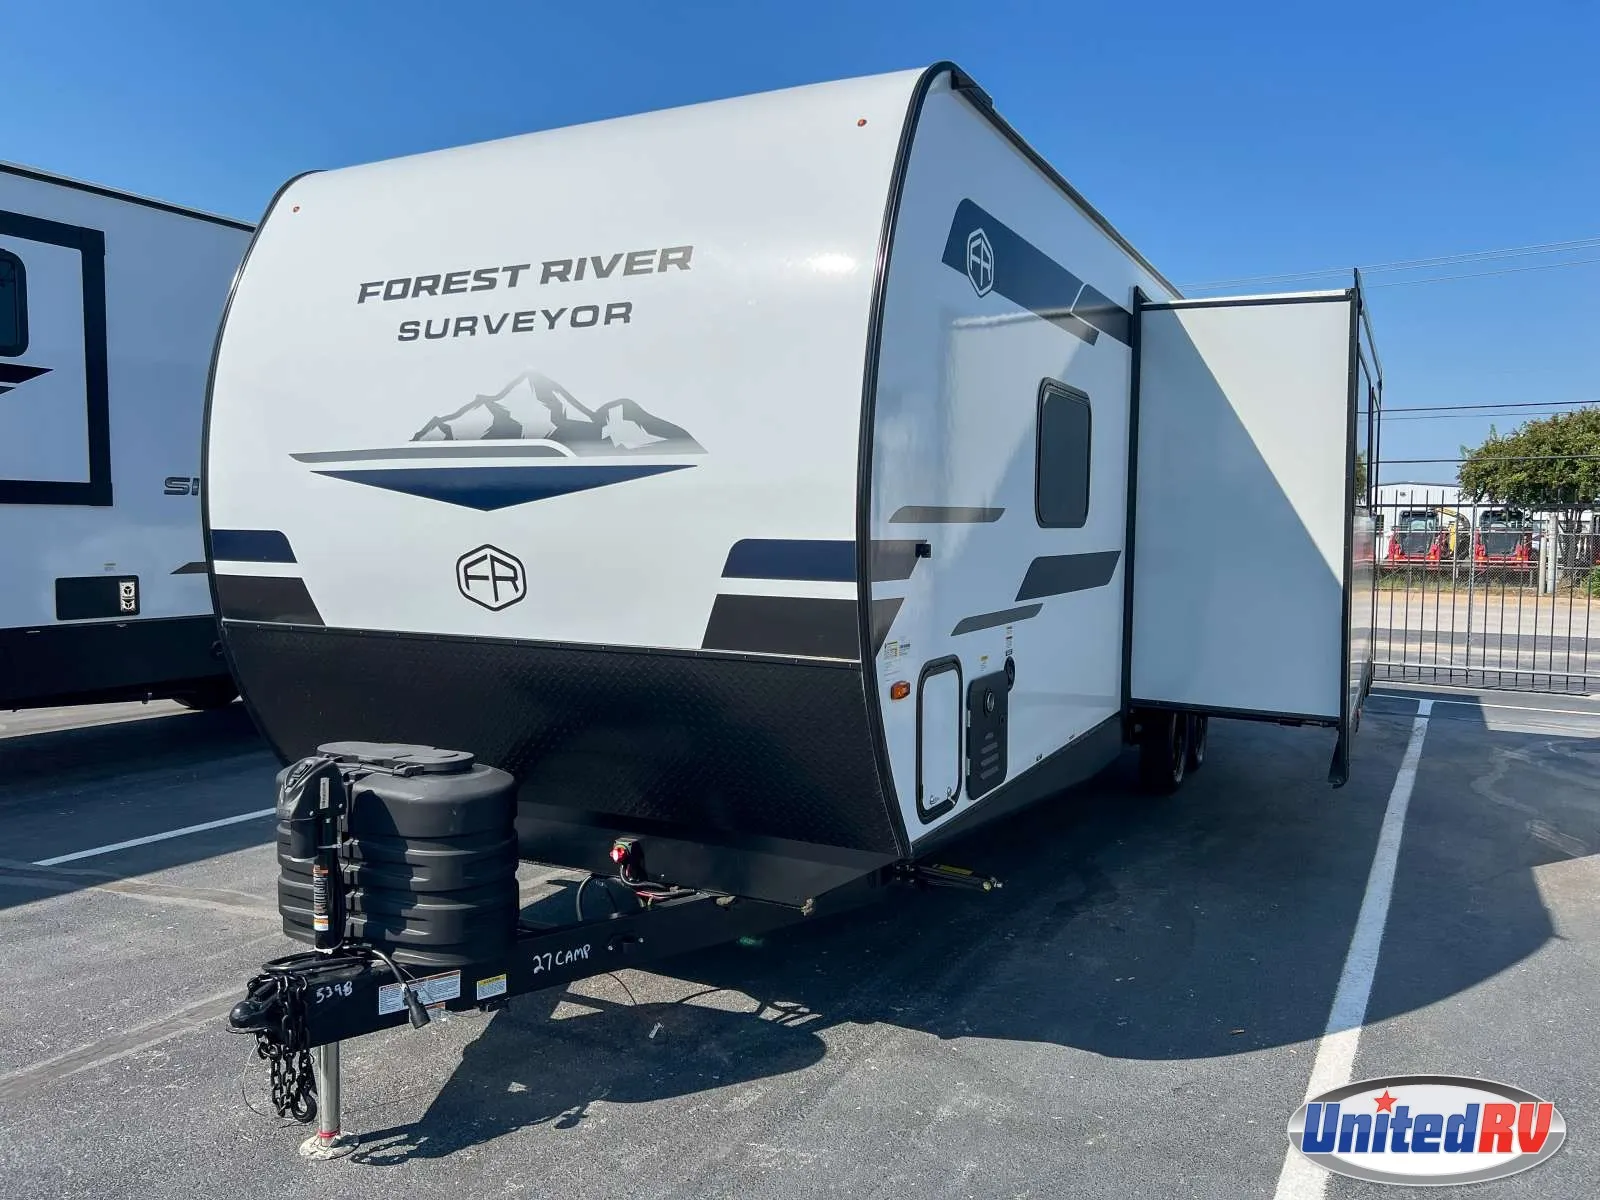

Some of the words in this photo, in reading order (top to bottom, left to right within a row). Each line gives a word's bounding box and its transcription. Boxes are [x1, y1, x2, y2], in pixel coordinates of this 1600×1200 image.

[357, 264, 531, 305] FOREST
[540, 245, 694, 285] RIVER
[397, 302, 633, 342] SURVEYOR
[463, 553, 520, 603] FR
